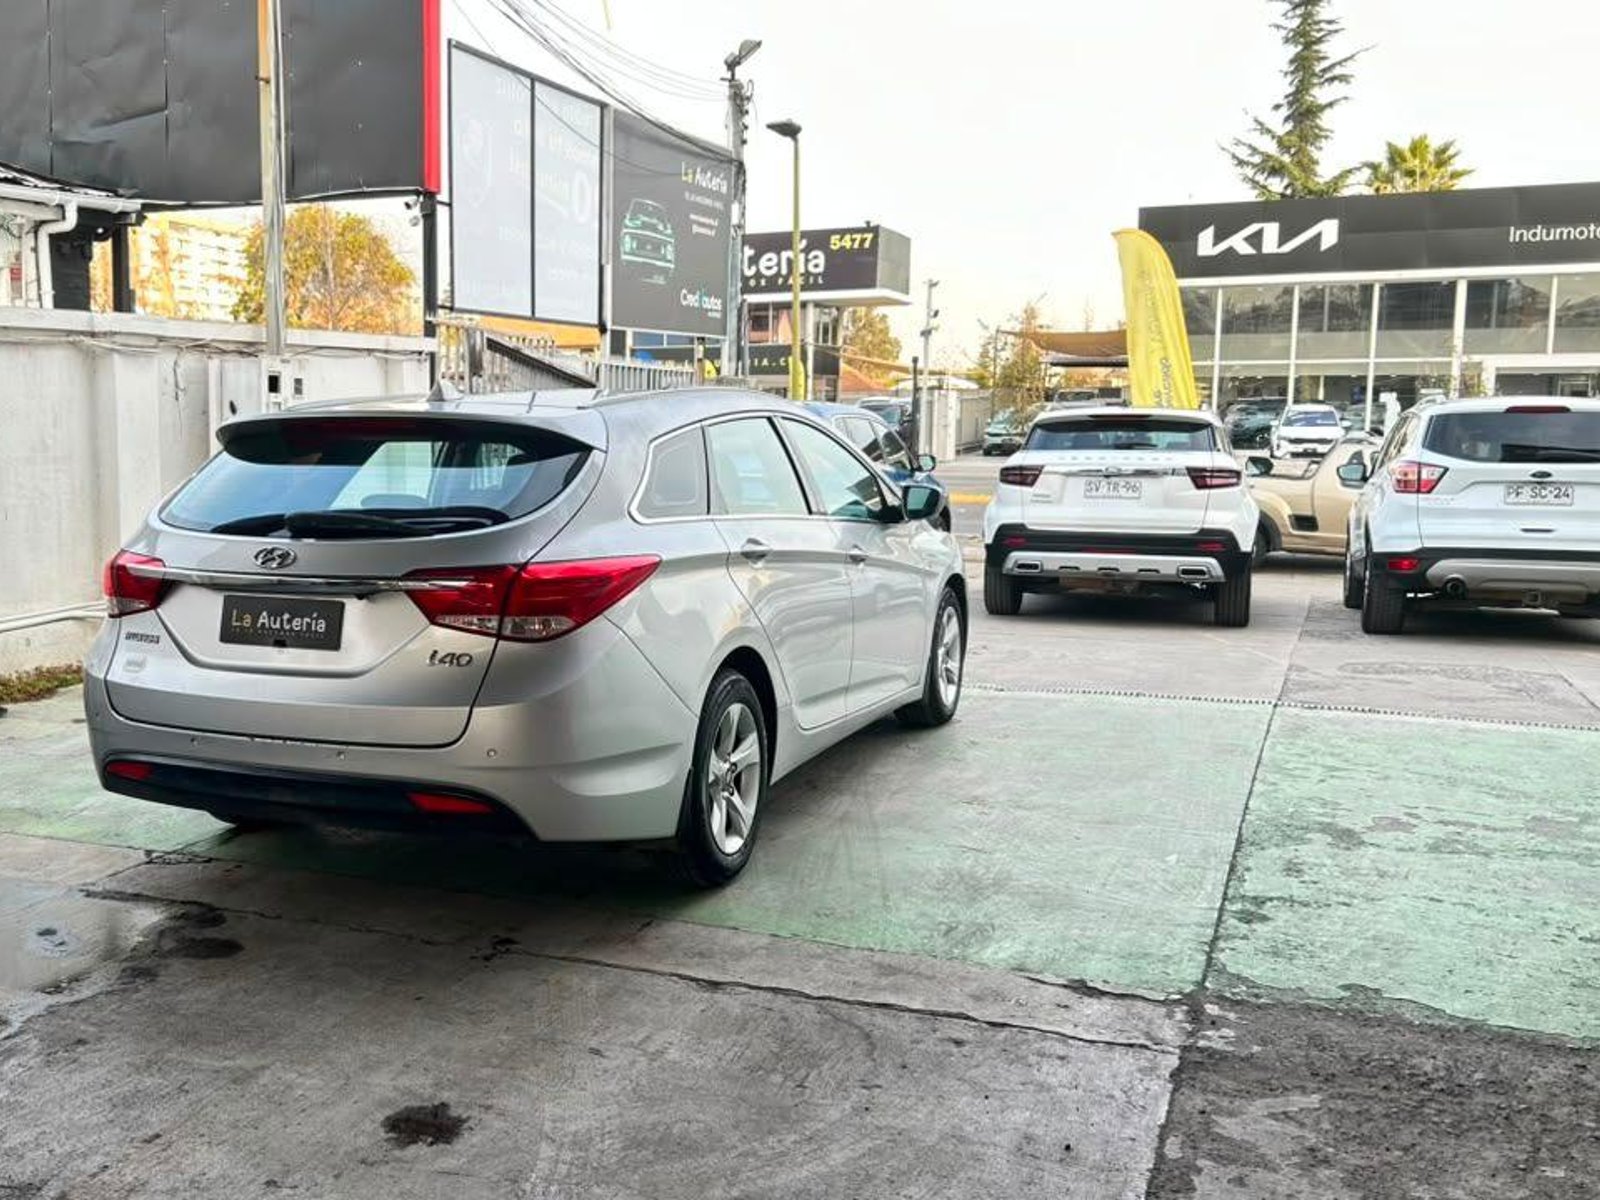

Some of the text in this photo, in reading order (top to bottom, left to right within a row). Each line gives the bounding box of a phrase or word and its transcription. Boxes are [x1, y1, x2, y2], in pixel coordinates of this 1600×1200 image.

[830, 232, 873, 250] 5477
[1197, 219, 1339, 256] KIA
[743, 239, 826, 276] tería
[231, 608, 326, 632] La Autería
[427, 649, 473, 667] i40
